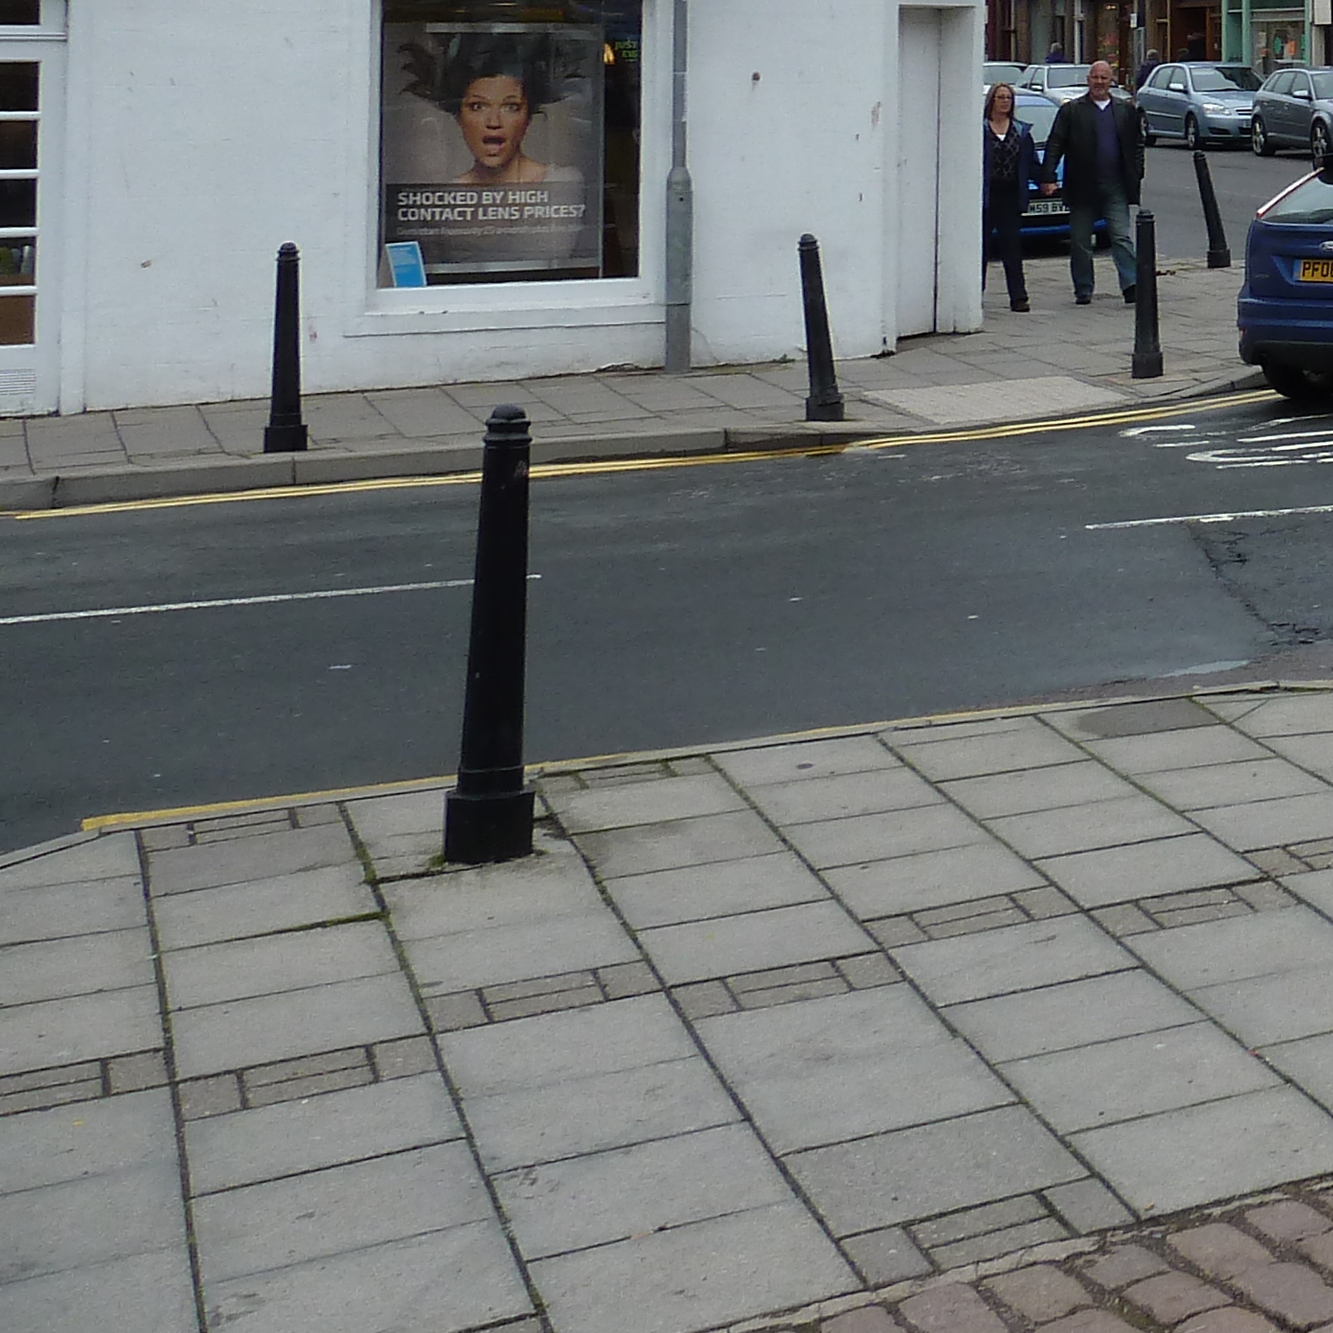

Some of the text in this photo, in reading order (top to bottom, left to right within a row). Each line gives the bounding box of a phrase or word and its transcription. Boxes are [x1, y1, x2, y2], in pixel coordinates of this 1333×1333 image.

[397, 190, 549, 206] SHOCKED BY HIGH
[397, 203, 586, 222] CONTACT LENS PRICES?
